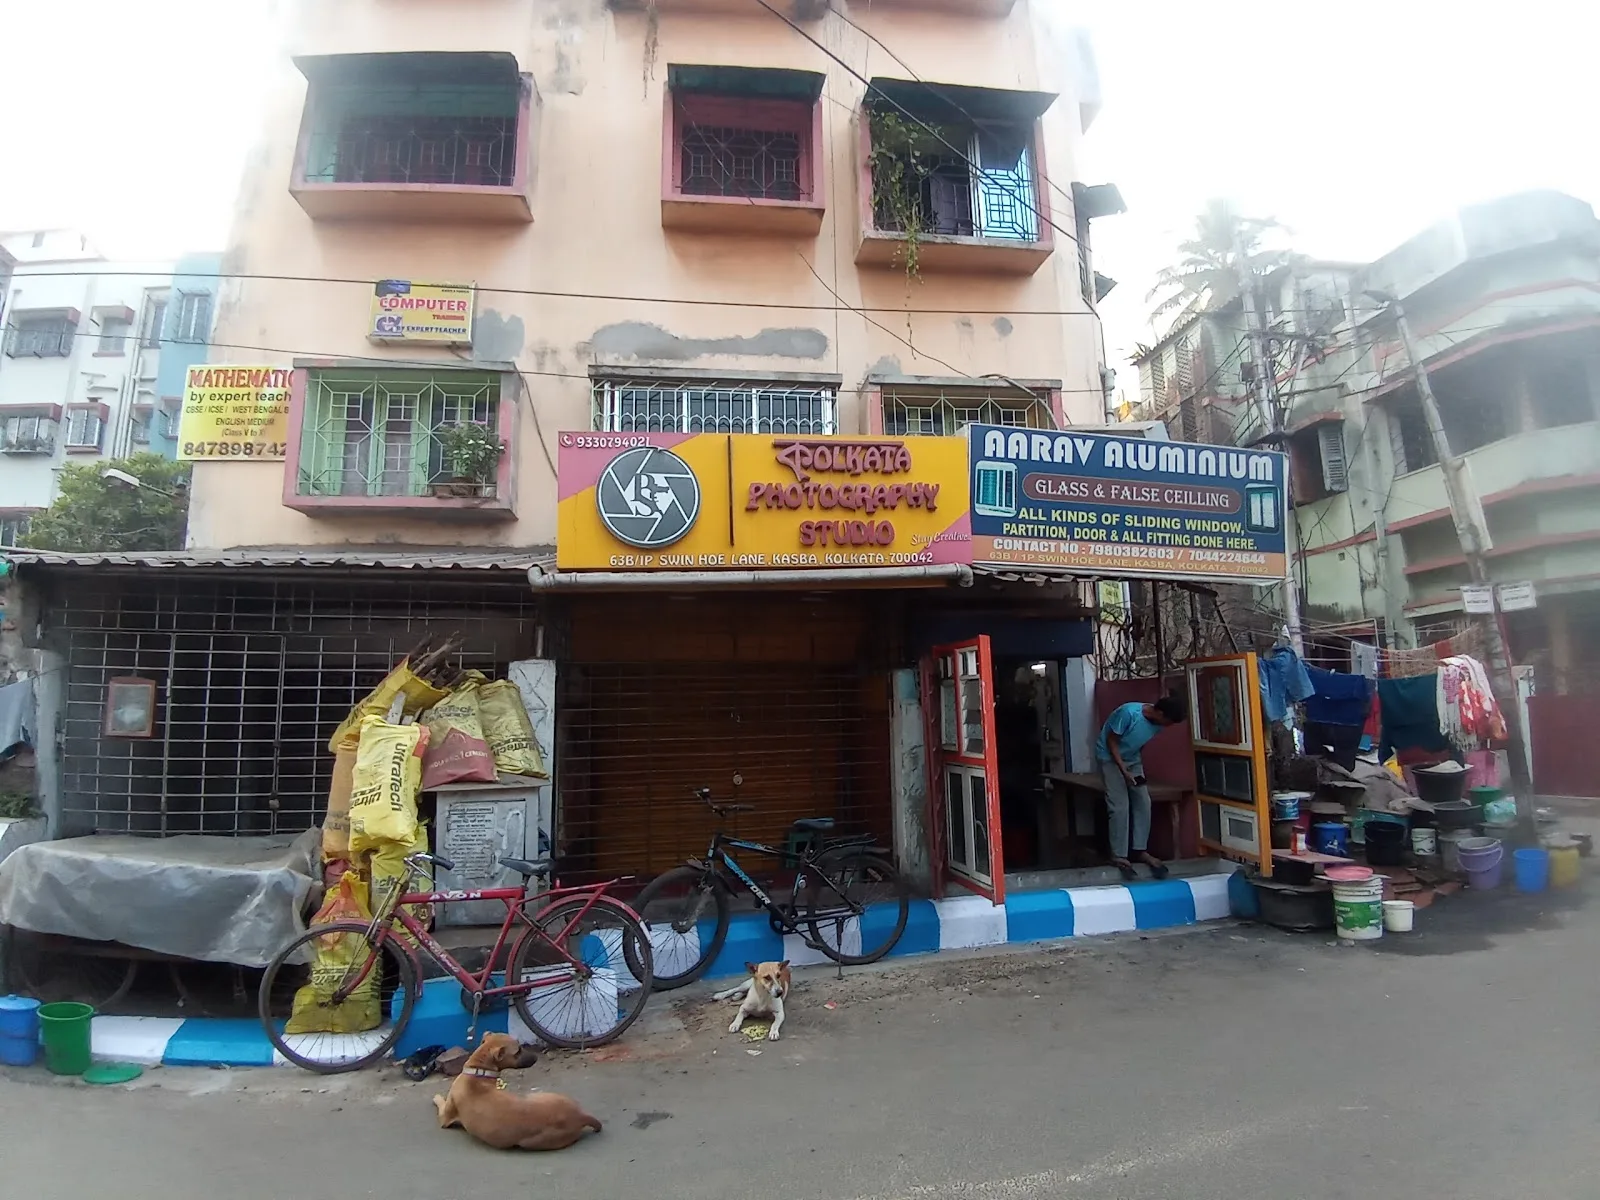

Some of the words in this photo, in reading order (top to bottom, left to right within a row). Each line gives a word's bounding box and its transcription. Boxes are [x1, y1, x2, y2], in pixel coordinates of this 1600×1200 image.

[379, 297, 467, 311] COMPUTER
[435, 326, 467, 334] TEACHER
[190, 391, 205, 403] by
[210, 392, 251, 403] expert
[255, 391, 292, 401] teach
[186, 405, 203, 413] CBSE
[209, 405, 224, 413] ICSE
[232, 405, 251, 413] WEST
[254, 405, 282, 413] BENGAL
[577, 436, 650, 448] 9330794021
[984, 430, 1095, 466] AARAV
[1104, 441, 1273, 481] ALUMINIUM
[745, 482, 939, 515] PHOTOGRAPHY
[1035, 479, 1089, 497] GLASS
[1094, 483, 1105, 498] &
[1111, 485, 1160, 503] FALSE
[1164, 489, 1229, 507] CEILLING
[1018, 507, 1047, 520] ALL
[1051, 510, 1097, 524] KINDS
[1101, 513, 1120, 525] OF
[1124, 515, 1180, 529] SLIDING
[1185, 519, 1245, 536] WINDOW,
[799, 520, 895, 547] STUDIO
[911, 534, 934, 548] Stay
[1003, 523, 1070, 540] PARTITION,
[1074, 528, 1107, 541] DOOR
[1110, 530, 1118, 541] &
[1122, 531, 1144, 544] ALL
[1147, 532, 1190, 546] FITTING
[1194, 535, 1222, 548] DONE
[1226, 538, 1257, 550] HERE.
[993, 538, 1057, 552] CONTACT
[1061, 542, 1078, 554] NO
[1088, 544, 1174, 560] 7980382603
[610, 554, 653, 566] 63B/1P
[659, 554, 694, 566] SWIN
[698, 554, 724, 565] HOE
[989, 551, 1011, 560] 63B
[1021, 553, 1035, 561] 1P
[1038, 553, 1068, 562] SWIN
[1071, 556, 1095, 564] HOE
[1180, 562, 1228, 571] KOLKATA
[389, 741, 408, 812] UltraTech
[430, 890, 482, 901] AVON
